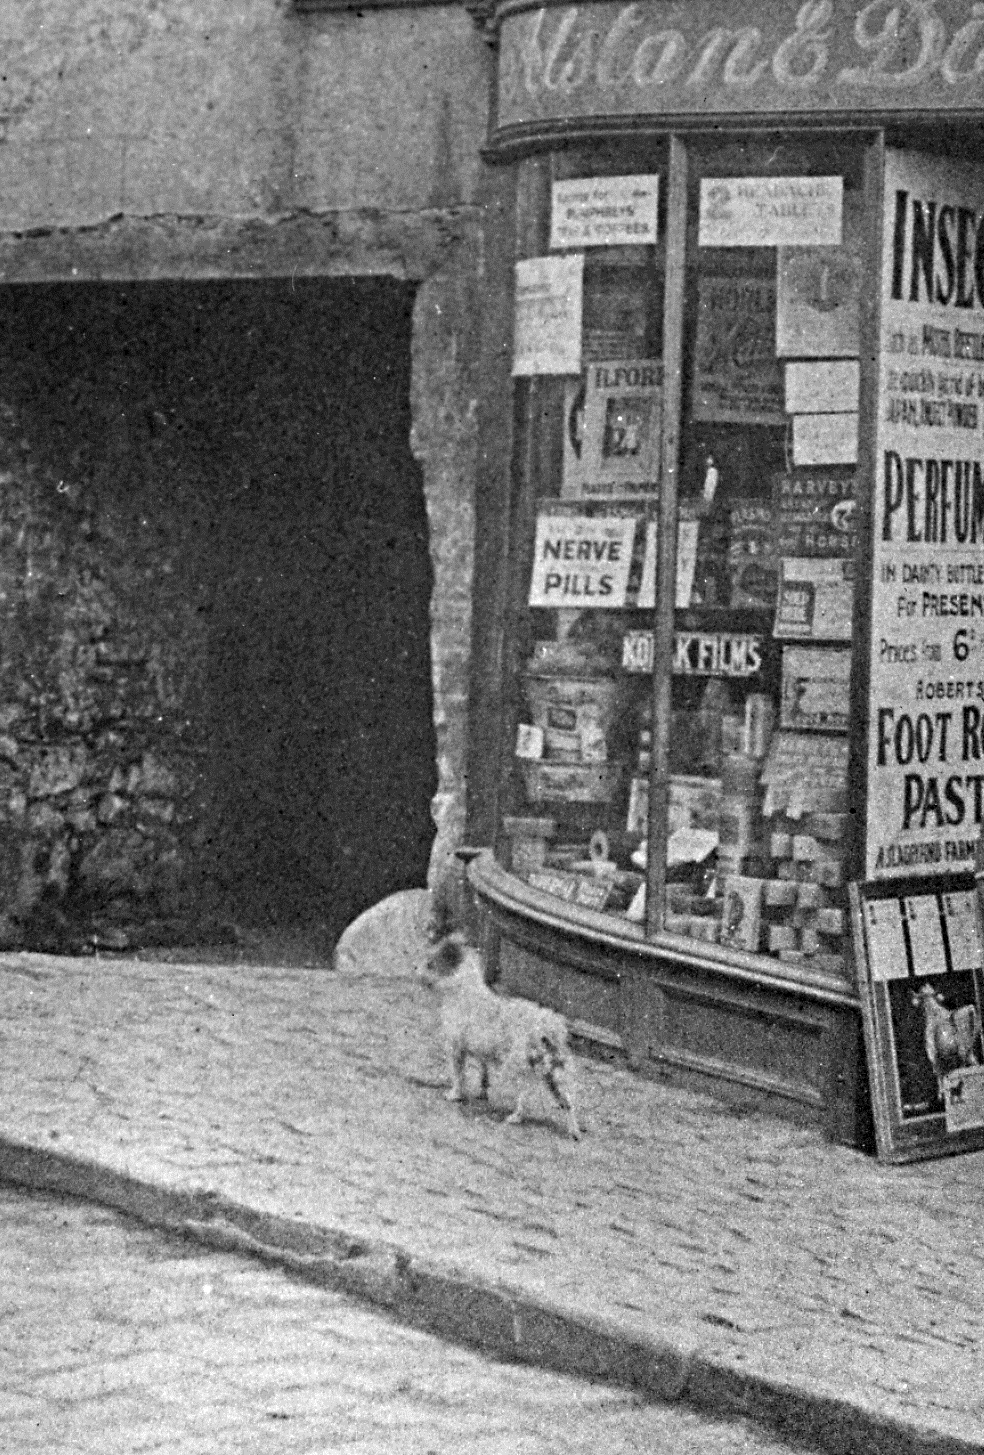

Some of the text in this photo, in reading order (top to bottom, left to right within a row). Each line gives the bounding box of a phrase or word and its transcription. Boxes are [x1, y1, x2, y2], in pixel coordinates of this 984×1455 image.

[543, 538, 622, 562] NERVE
[543, 573, 614, 596] PILLS
[698, 637, 762, 673] FILMS
[877, 706, 953, 767] FOOT
